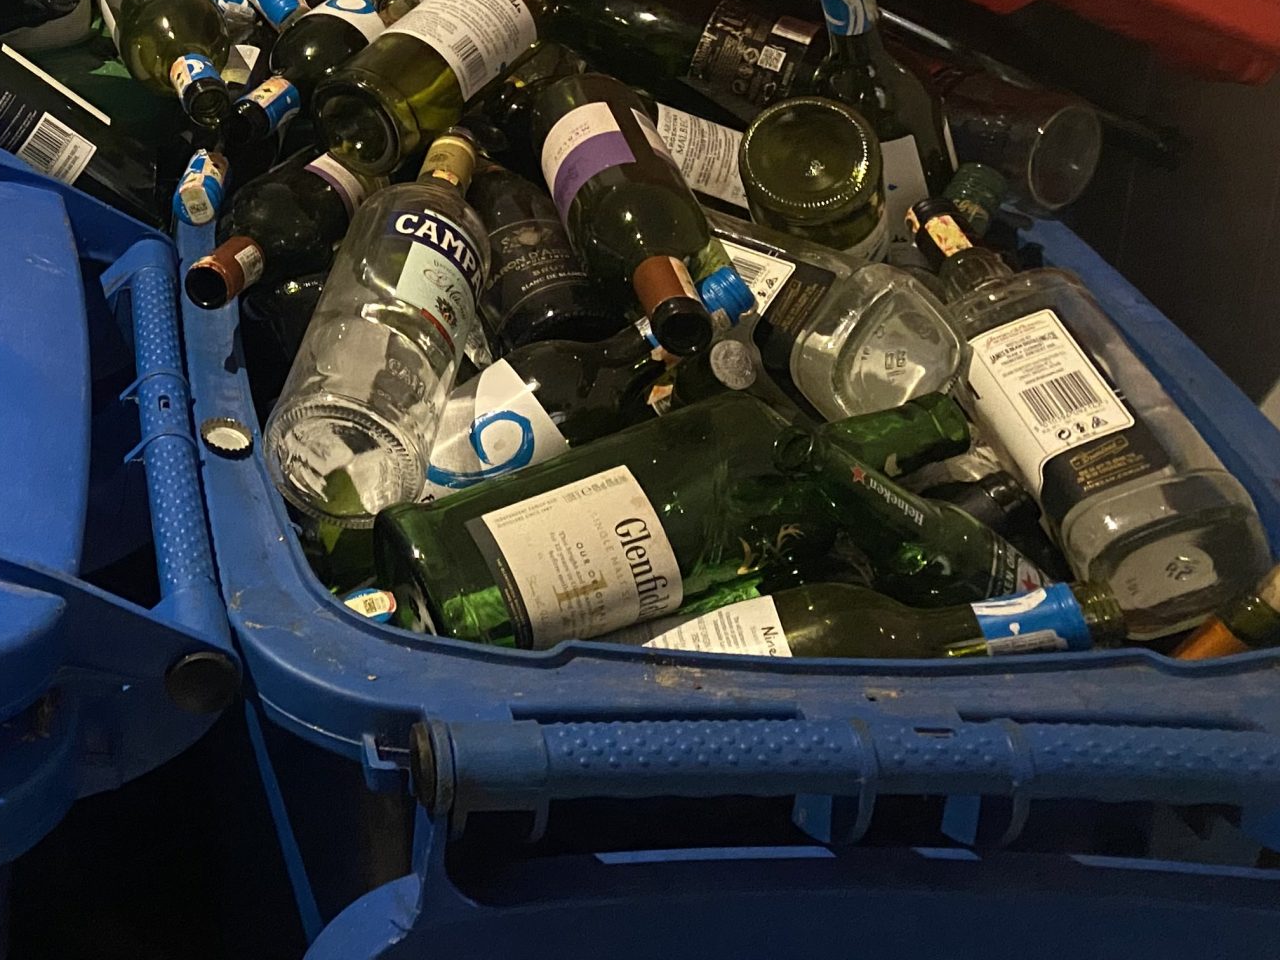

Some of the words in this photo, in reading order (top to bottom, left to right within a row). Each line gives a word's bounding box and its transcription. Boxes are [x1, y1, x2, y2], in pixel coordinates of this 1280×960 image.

[673, 117, 690, 155] MALBEC
[870, 477, 925, 526] Heineken
[575, 542, 591, 565] OUR
[614, 516, 670, 619] Glenfidd
[761, 624, 777, 657] Nine
